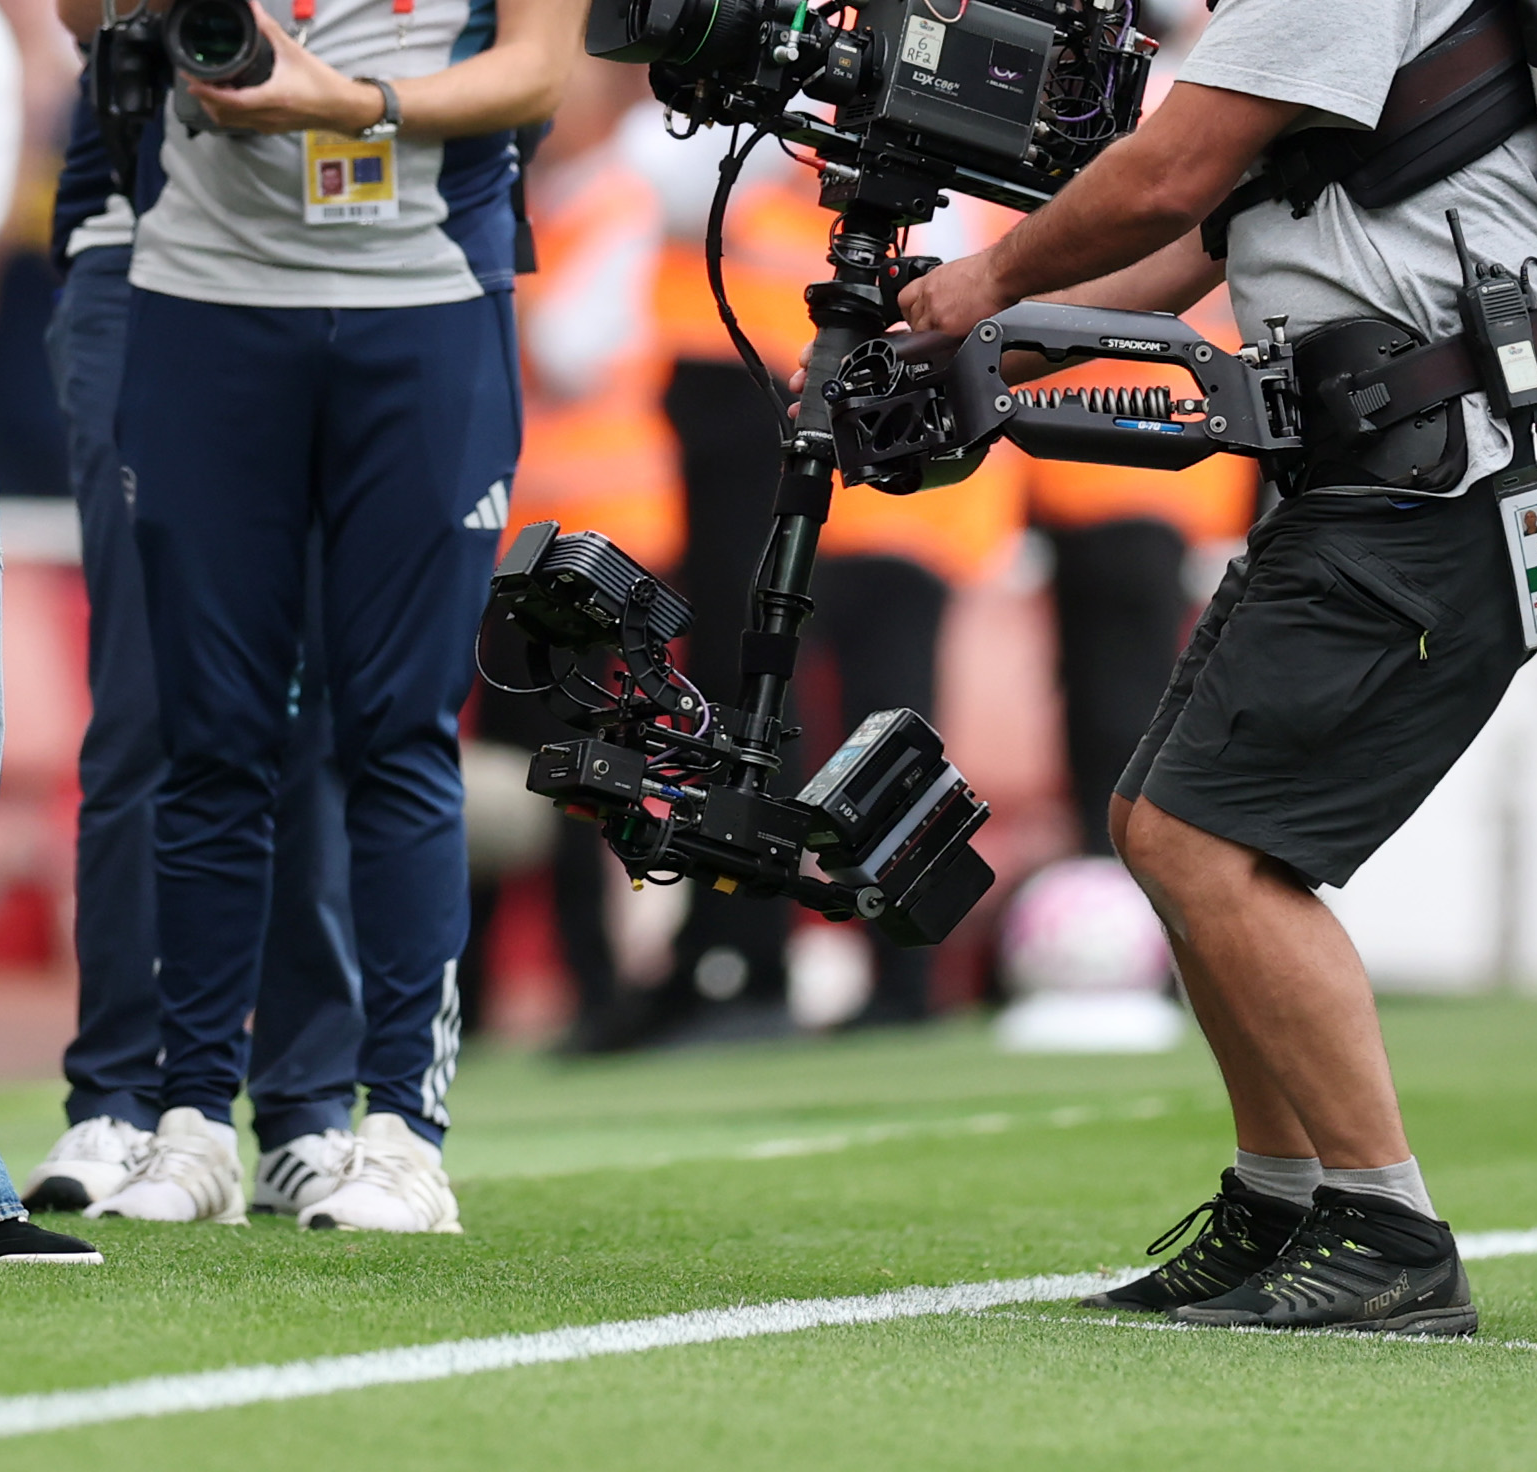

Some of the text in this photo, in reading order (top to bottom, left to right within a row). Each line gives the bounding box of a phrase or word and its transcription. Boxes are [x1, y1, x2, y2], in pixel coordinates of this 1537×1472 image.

[917, 37, 928, 51] 6
[906, 47, 932, 65] RF2
[912, 70, 934, 86] LDX
[1107, 338, 1161, 352] STEADICAM
[1137, 420, 1162, 431] G-70
